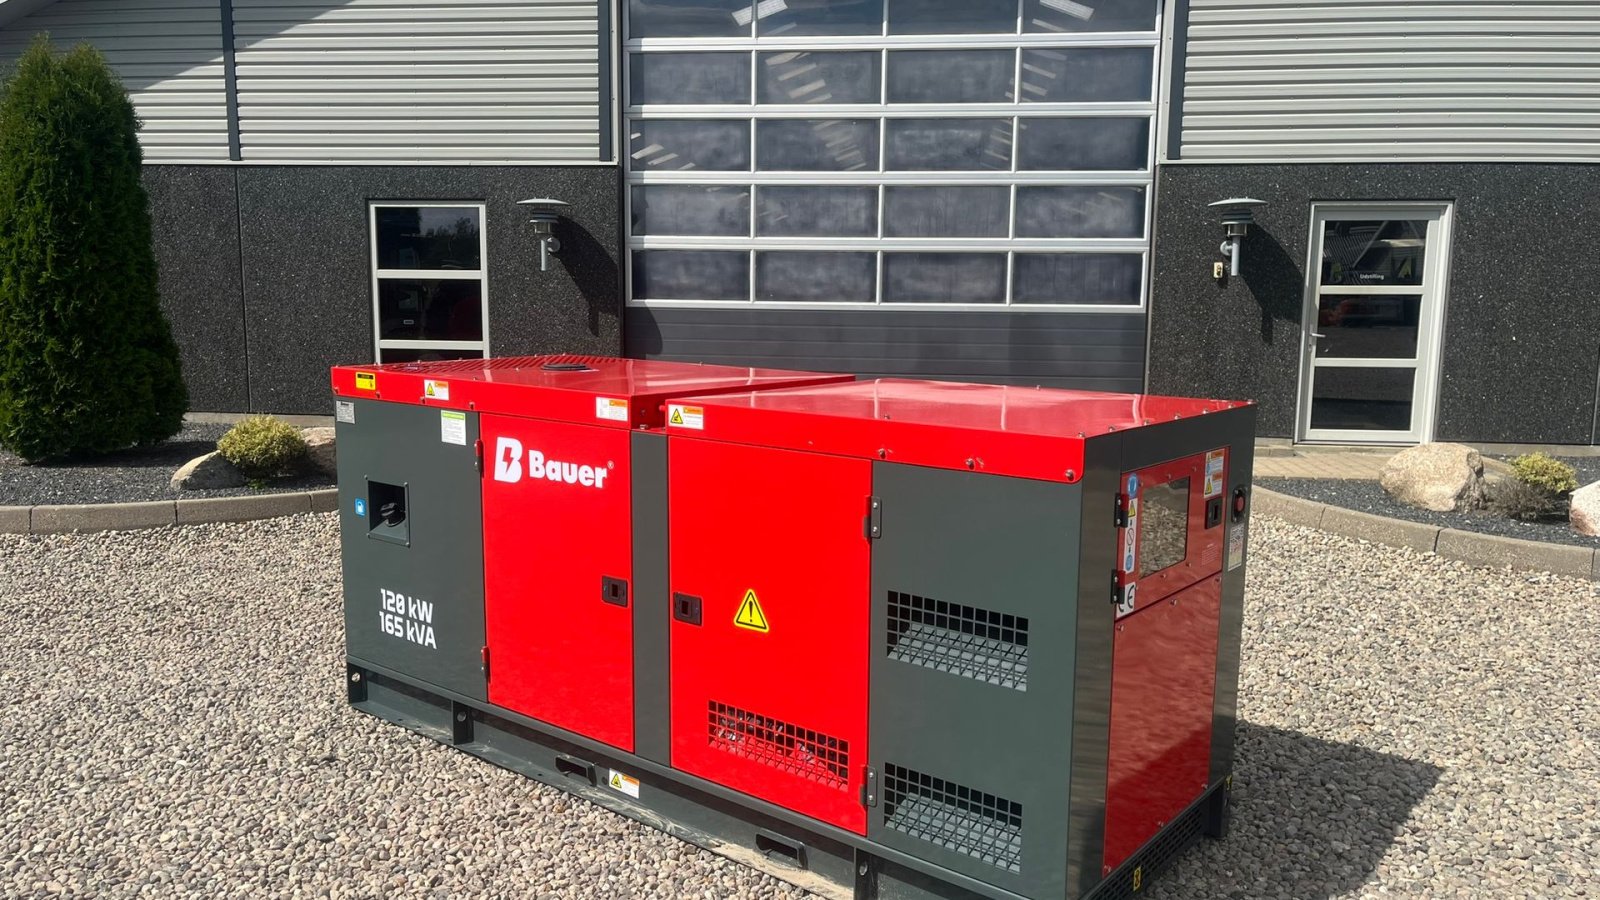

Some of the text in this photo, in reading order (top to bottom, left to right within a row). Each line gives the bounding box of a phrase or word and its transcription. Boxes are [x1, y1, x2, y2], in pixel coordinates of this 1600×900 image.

[380, 588, 433, 624] 120 kW
[379, 610, 437, 650] 165 kVA
